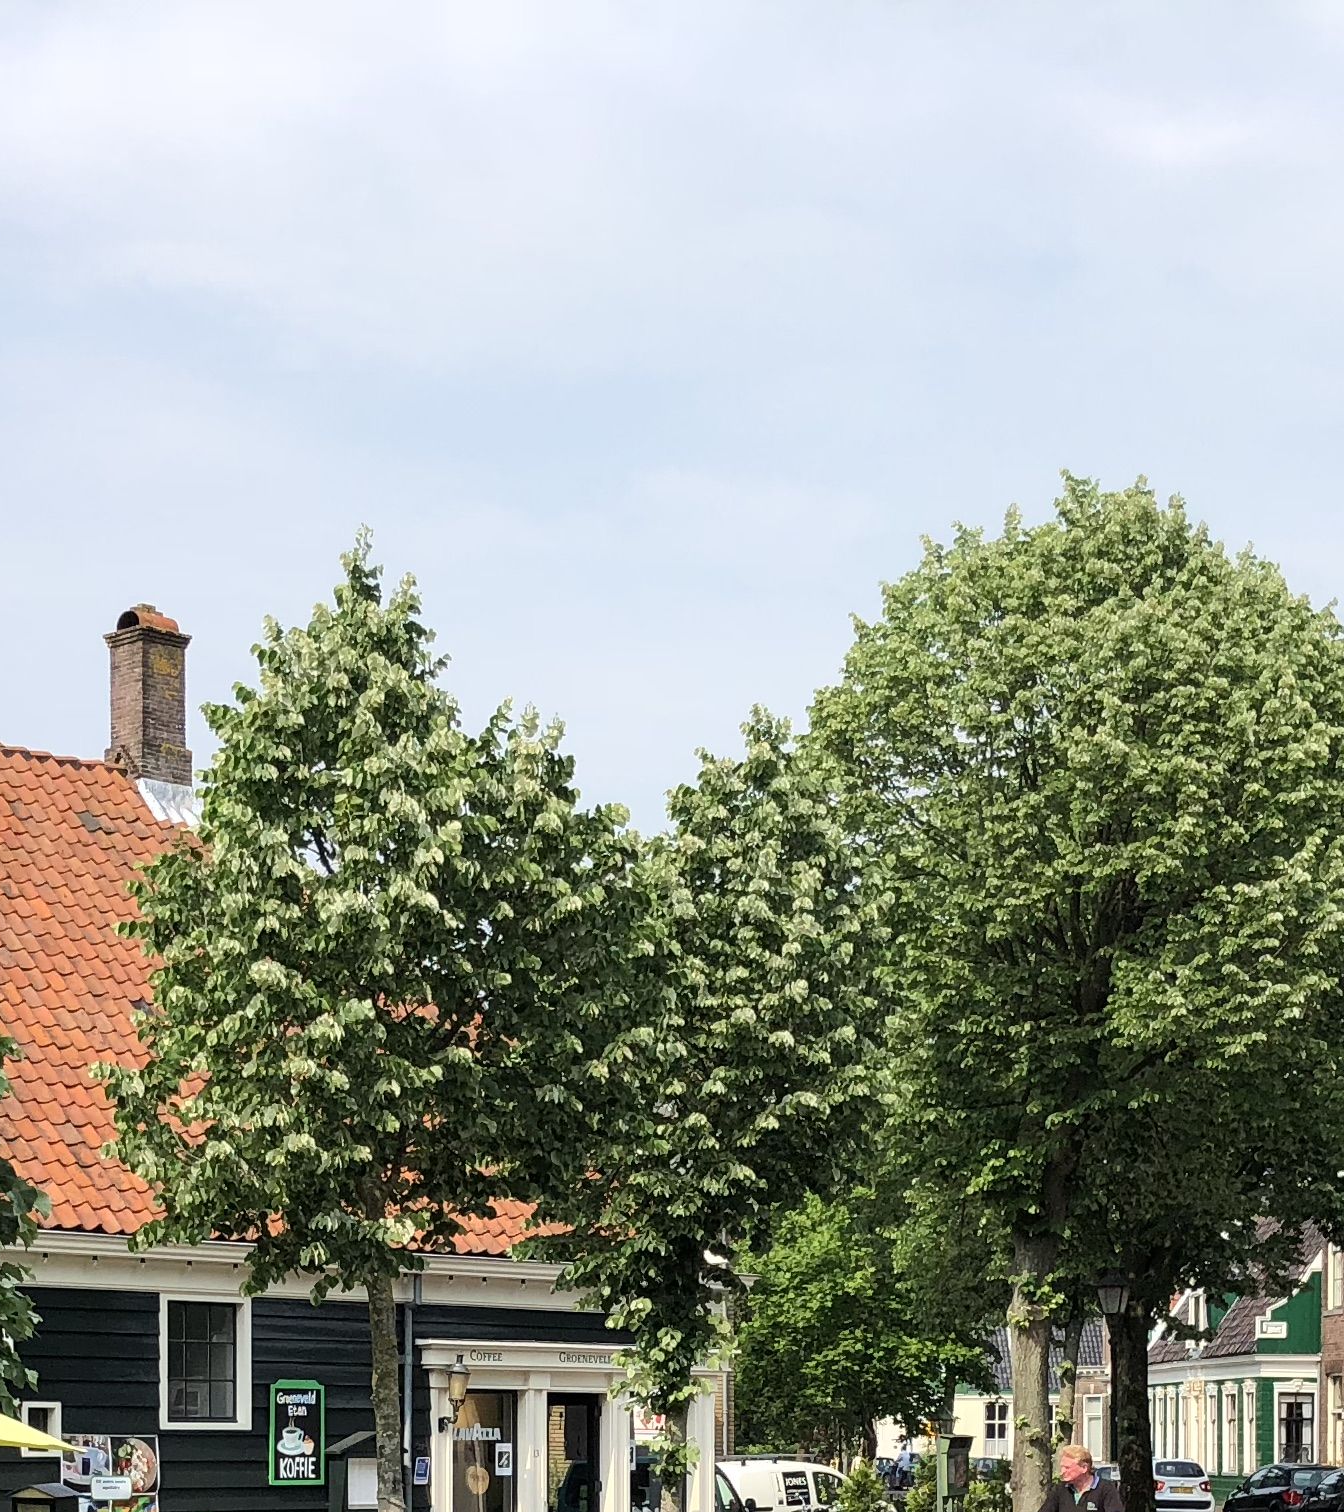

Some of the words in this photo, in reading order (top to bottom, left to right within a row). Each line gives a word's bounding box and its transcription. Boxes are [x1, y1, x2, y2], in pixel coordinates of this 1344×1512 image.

[470, 1350, 503, 1362] COFFEE
[559, 1352, 611, 1364] GROENEVEL
[277, 1390, 316, 1405] Groeneveld
[279, 1456, 316, 1478] KOFFIE
